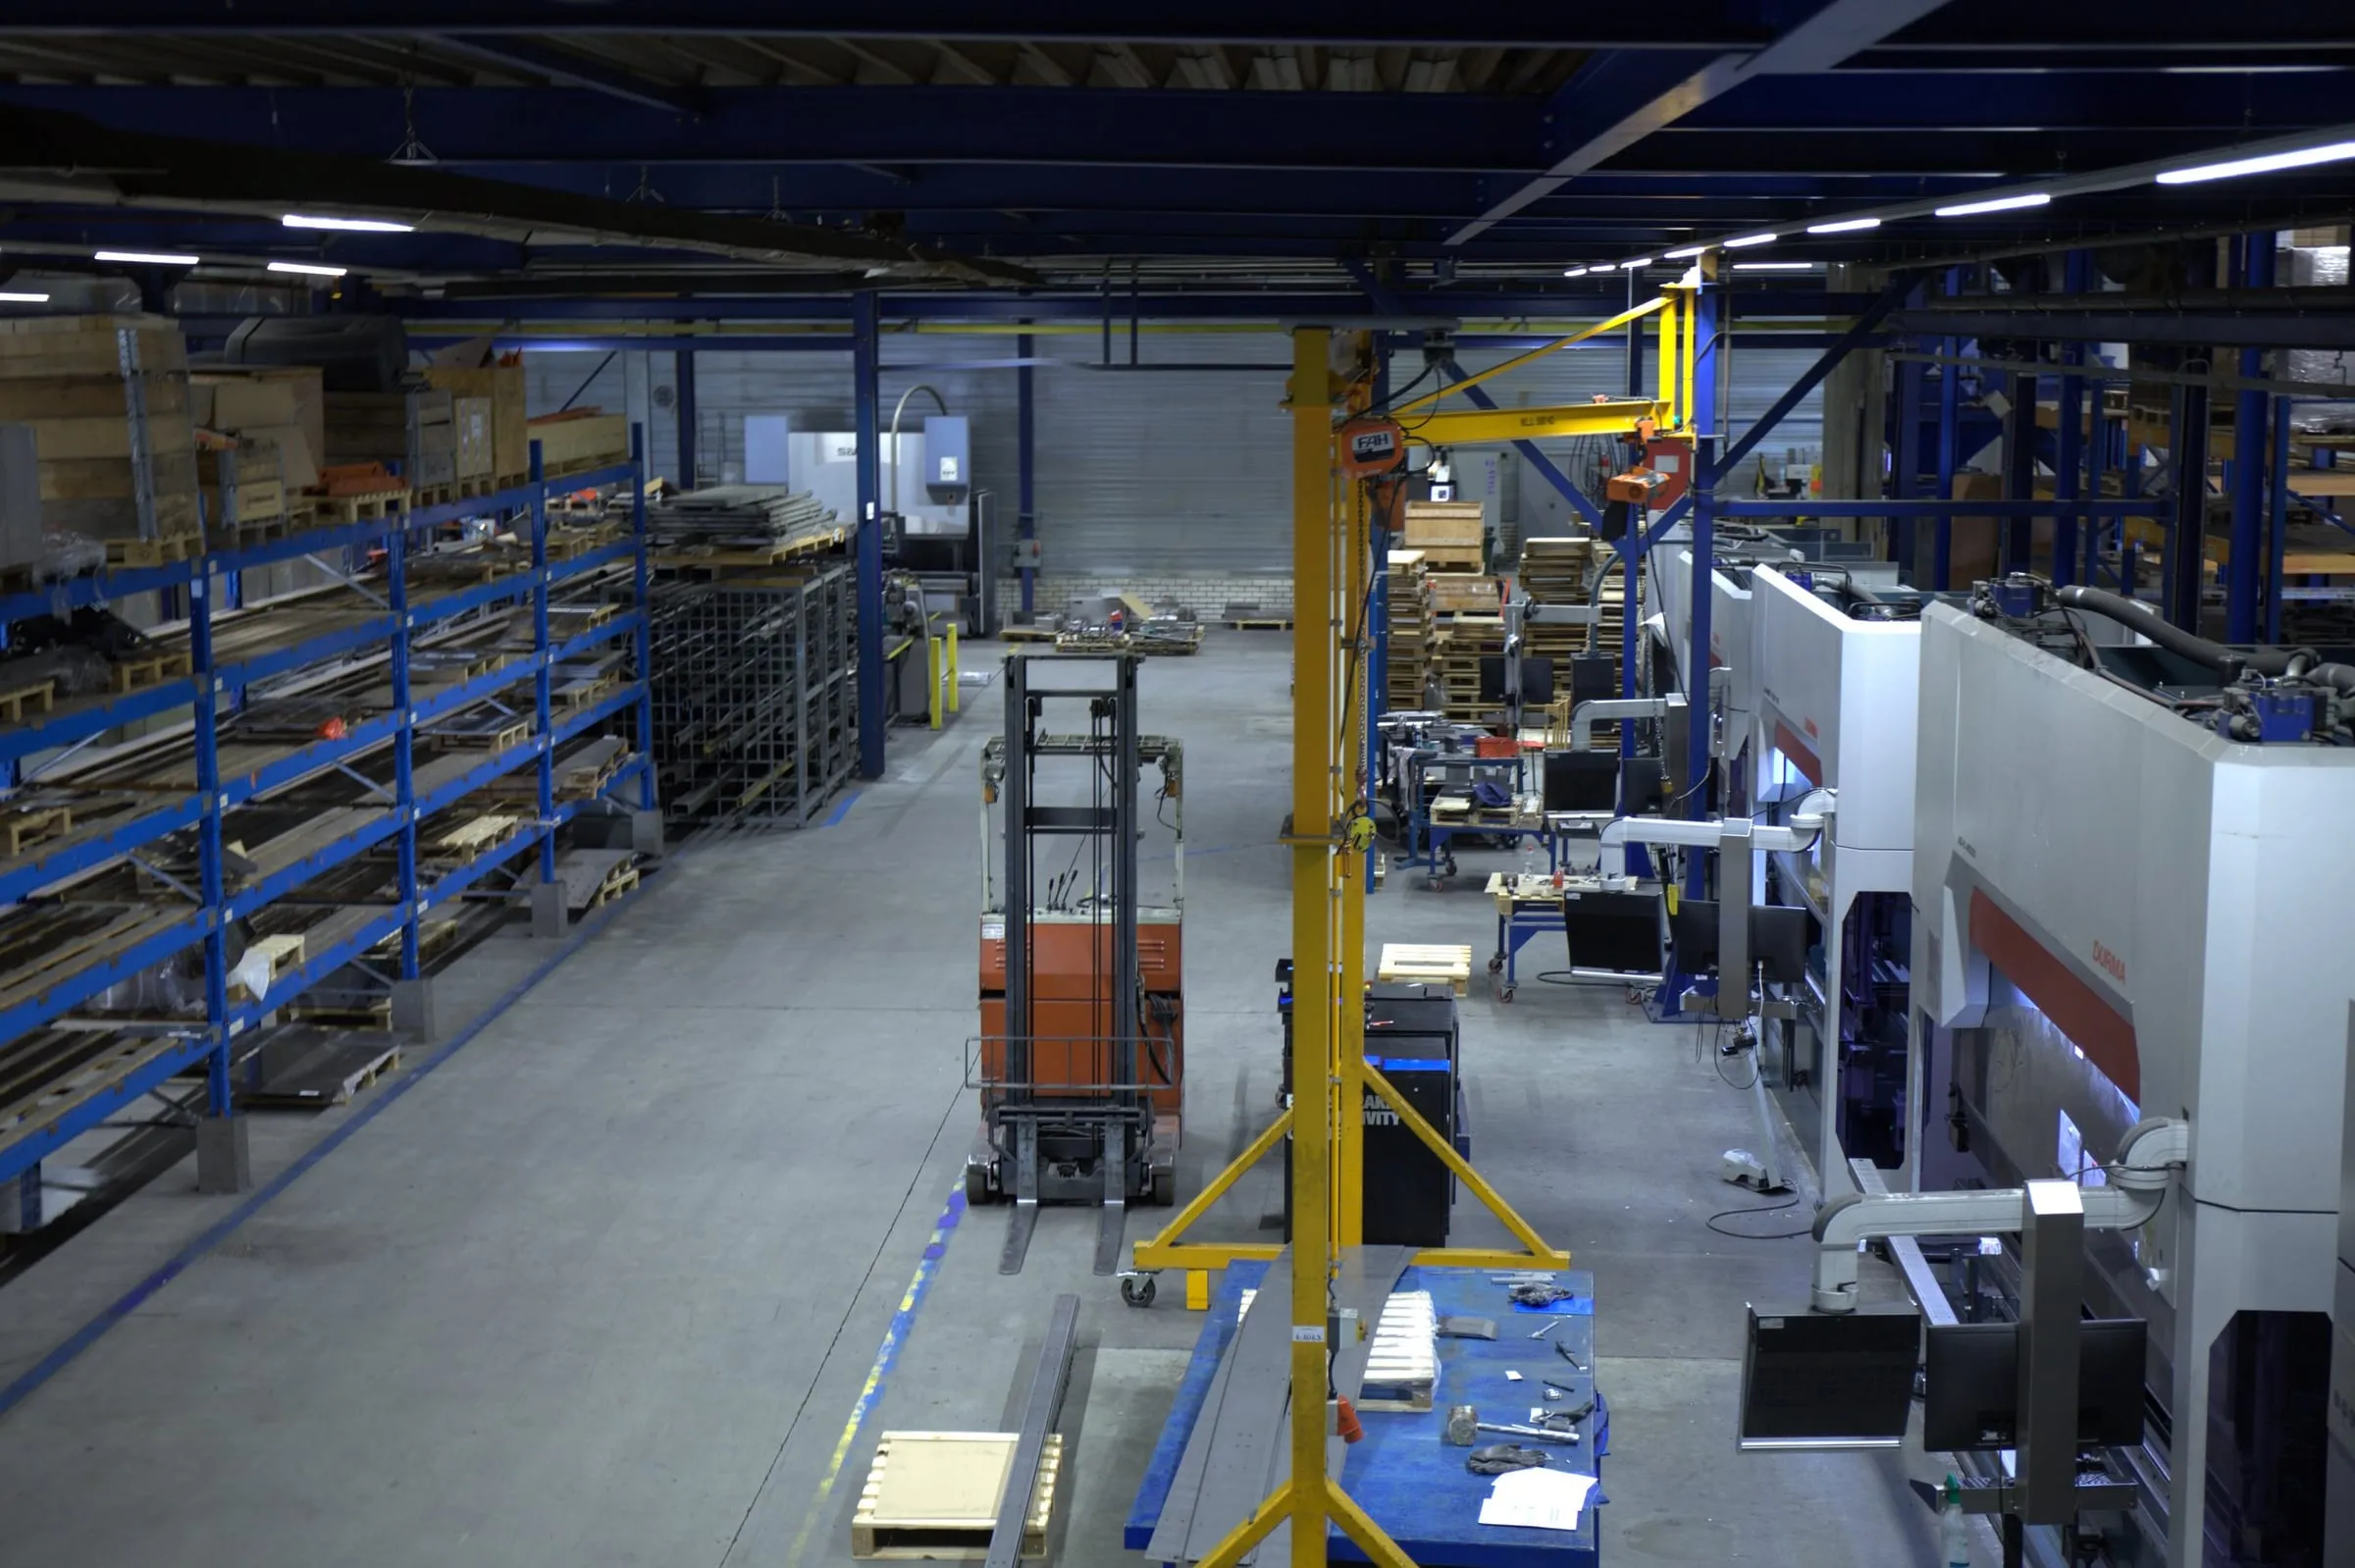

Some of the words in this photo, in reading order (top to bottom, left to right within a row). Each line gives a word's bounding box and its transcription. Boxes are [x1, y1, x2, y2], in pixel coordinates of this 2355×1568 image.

[1357, 433, 1388, 448] FAH
[2092, 939, 2125, 986] DURMA
[1362, 1111, 1399, 1125] IVITY
